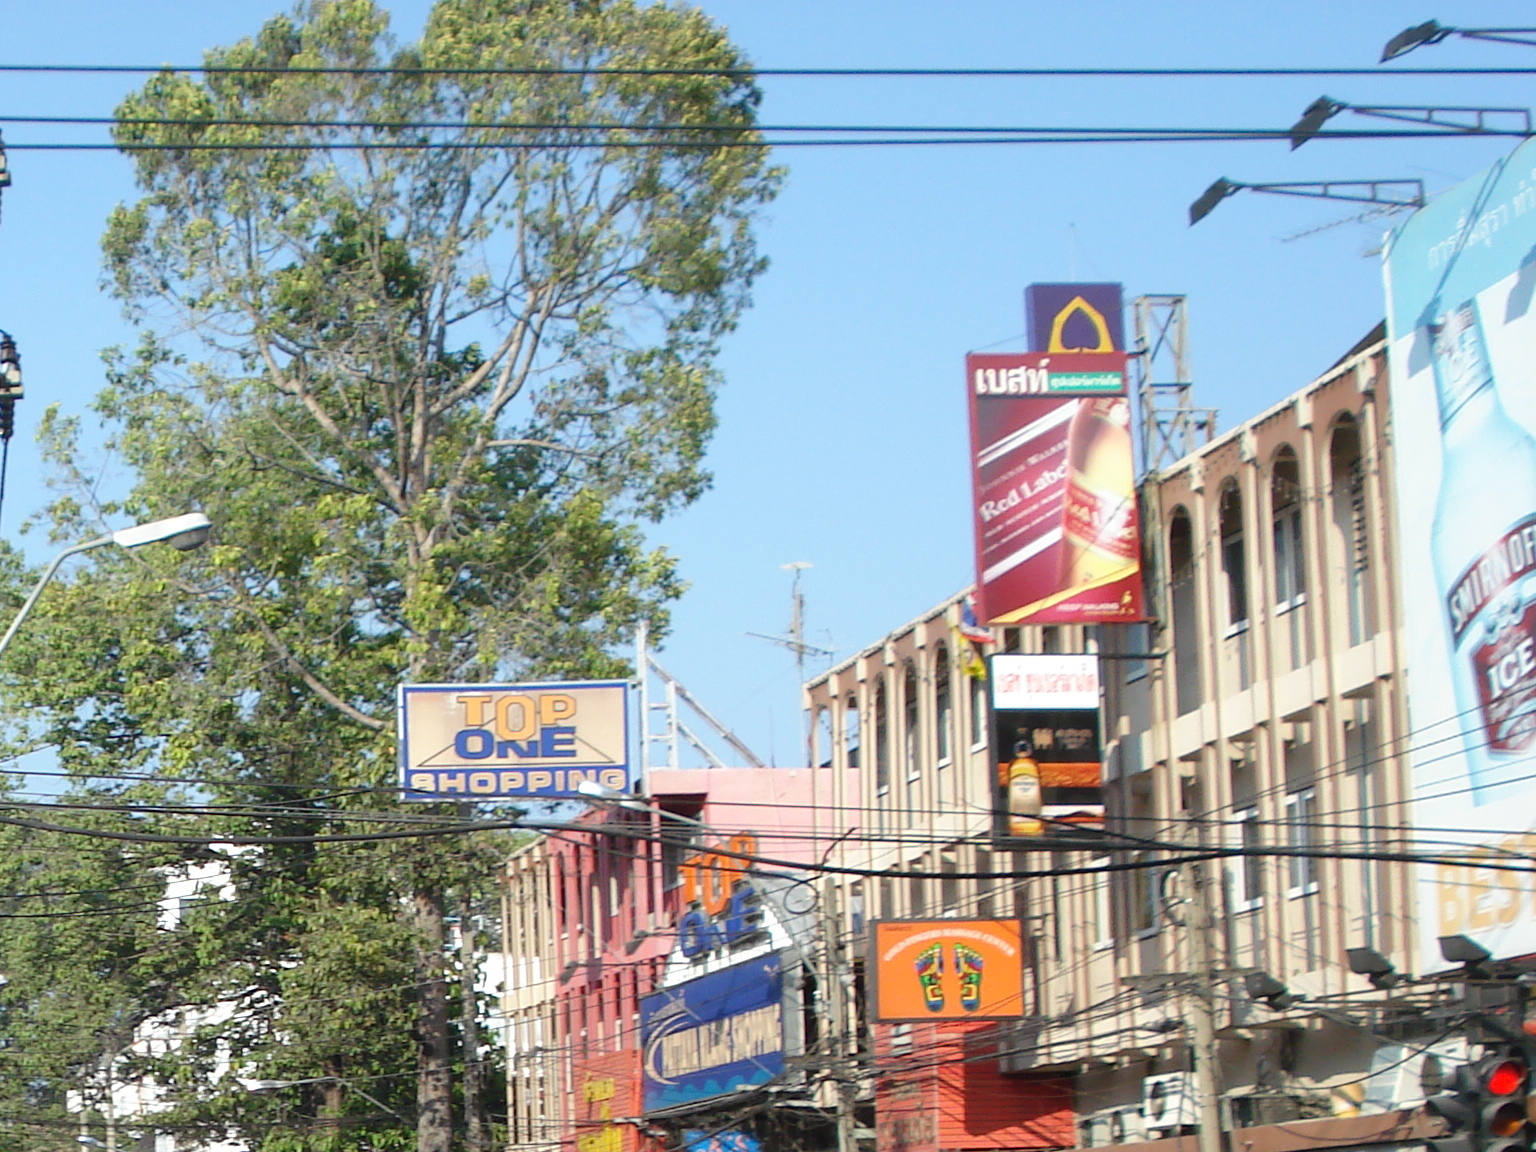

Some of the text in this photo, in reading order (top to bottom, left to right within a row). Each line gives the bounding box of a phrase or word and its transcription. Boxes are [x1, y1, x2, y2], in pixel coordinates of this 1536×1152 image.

[976, 358, 1051, 394] เบสท์
[979, 488, 1023, 523] Red
[1487, 636, 1536, 701] ICE
[456, 693, 577, 741] TOP
[454, 726, 577, 760] ONE
[410, 767, 577, 795] SHOPPING
[677, 830, 757, 916] TOP
[680, 886, 758, 958] ONE
